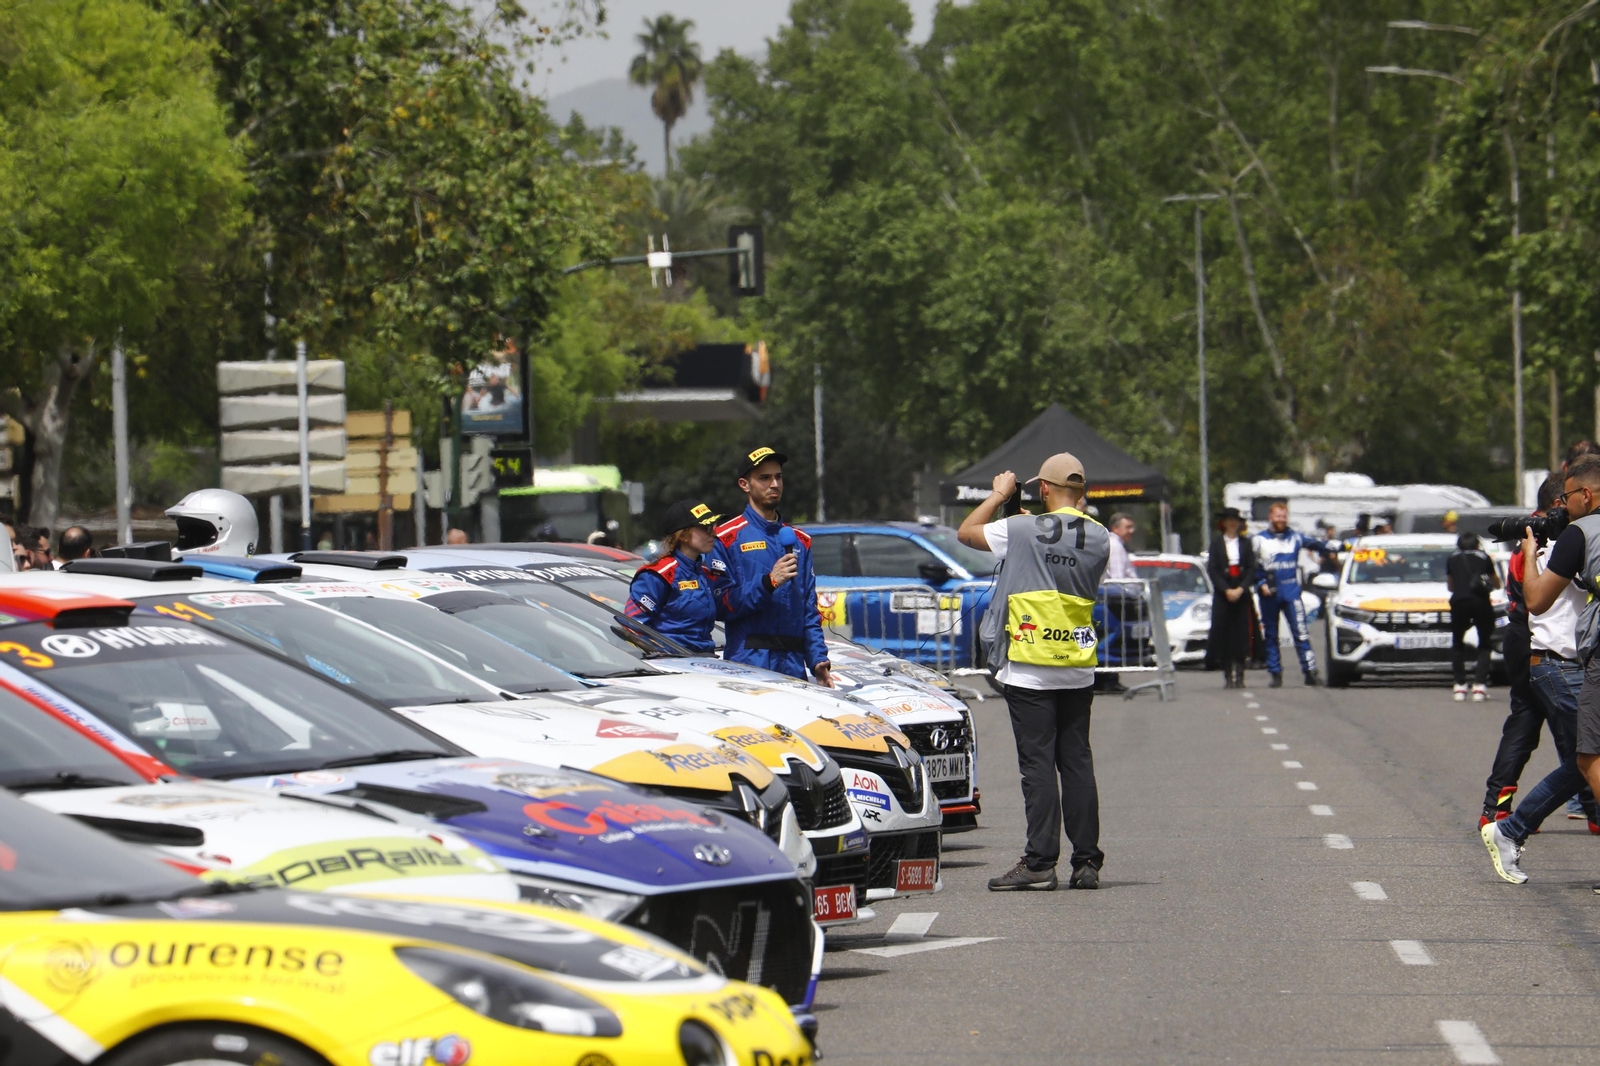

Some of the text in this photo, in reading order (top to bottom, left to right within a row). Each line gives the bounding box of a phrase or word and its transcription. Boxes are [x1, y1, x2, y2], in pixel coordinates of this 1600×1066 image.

[1035, 514, 1086, 549] 91
[1045, 553, 1076, 568] FOTO
[925, 758, 948, 778] 3876
[853, 773, 879, 792] AON
[856, 793, 887, 806] MICHELIN
[862, 808, 882, 823] ARC
[109, 941, 344, 977] ourense
